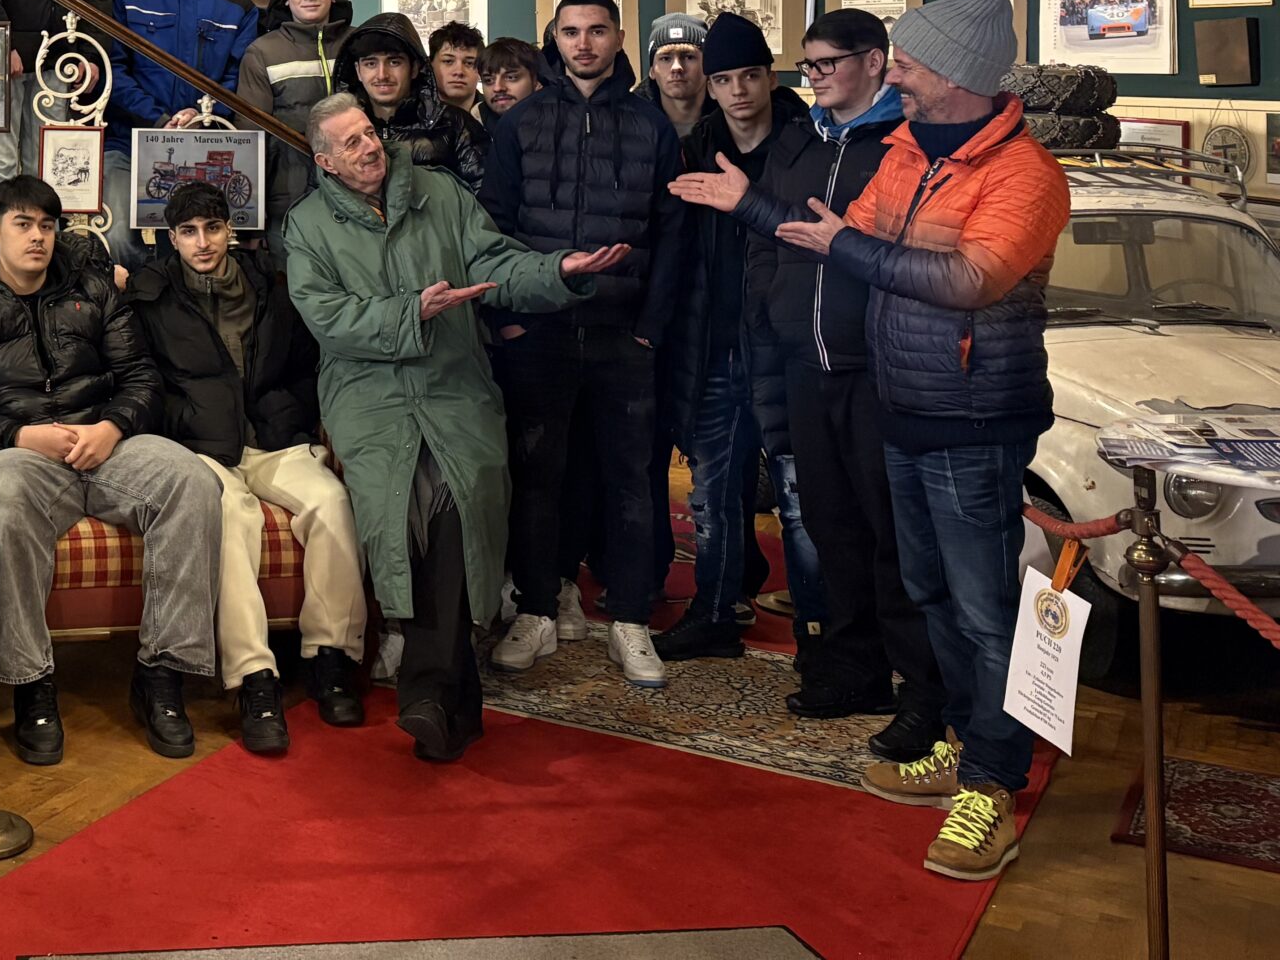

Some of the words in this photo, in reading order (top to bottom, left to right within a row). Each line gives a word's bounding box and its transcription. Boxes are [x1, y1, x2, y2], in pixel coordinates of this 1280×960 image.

[145, 135, 159, 143] 140
[161, 136, 185, 144] Jahre
[193, 136, 223, 144] Marcus
[225, 136, 251, 145] Wagen
